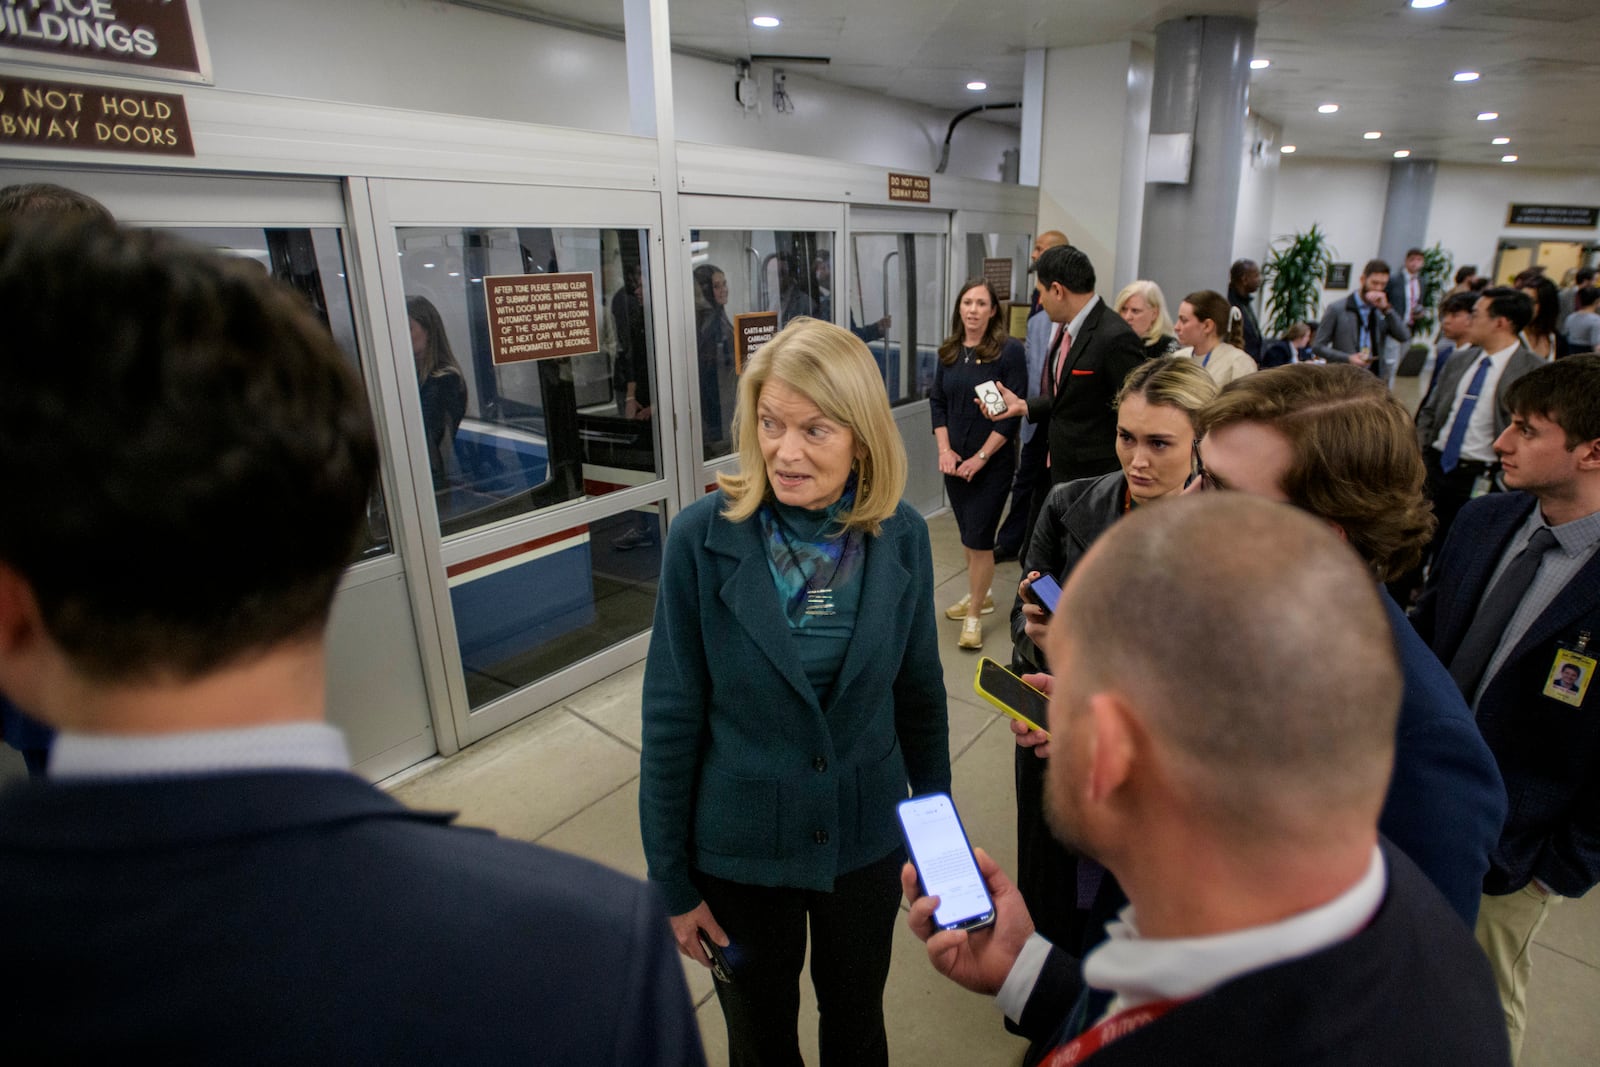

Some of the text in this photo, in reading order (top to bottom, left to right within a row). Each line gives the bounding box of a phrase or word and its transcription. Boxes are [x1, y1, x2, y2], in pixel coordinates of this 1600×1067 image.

[0, 5, 158, 56] ILDINGS
[22, 88, 84, 112] NOT
[101, 95, 171, 119] HOLD
[95, 122, 177, 146] DOORS
[494, 281, 587, 294] AFTER TONE PLEASE STAND CLEAR
[495, 296, 504, 305] OF
[506, 294, 530, 304] SUBWAY
[554, 291, 588, 301] INTERFERING
[496, 300, 589, 315] WITH DOOR MAY INITIATE AN
[498, 310, 589, 325] AUTOMATIC SAFETY SHUTDOWN
[501, 326, 512, 335] OF
[515, 324, 529, 333] THE
[531, 322, 559, 332] SUBWAY
[501, 328, 591, 345] THE NEXT CAR WILL ARRIVE
[501, 346, 508, 355] IN
[509, 342, 554, 353] APPROXIMATELY
